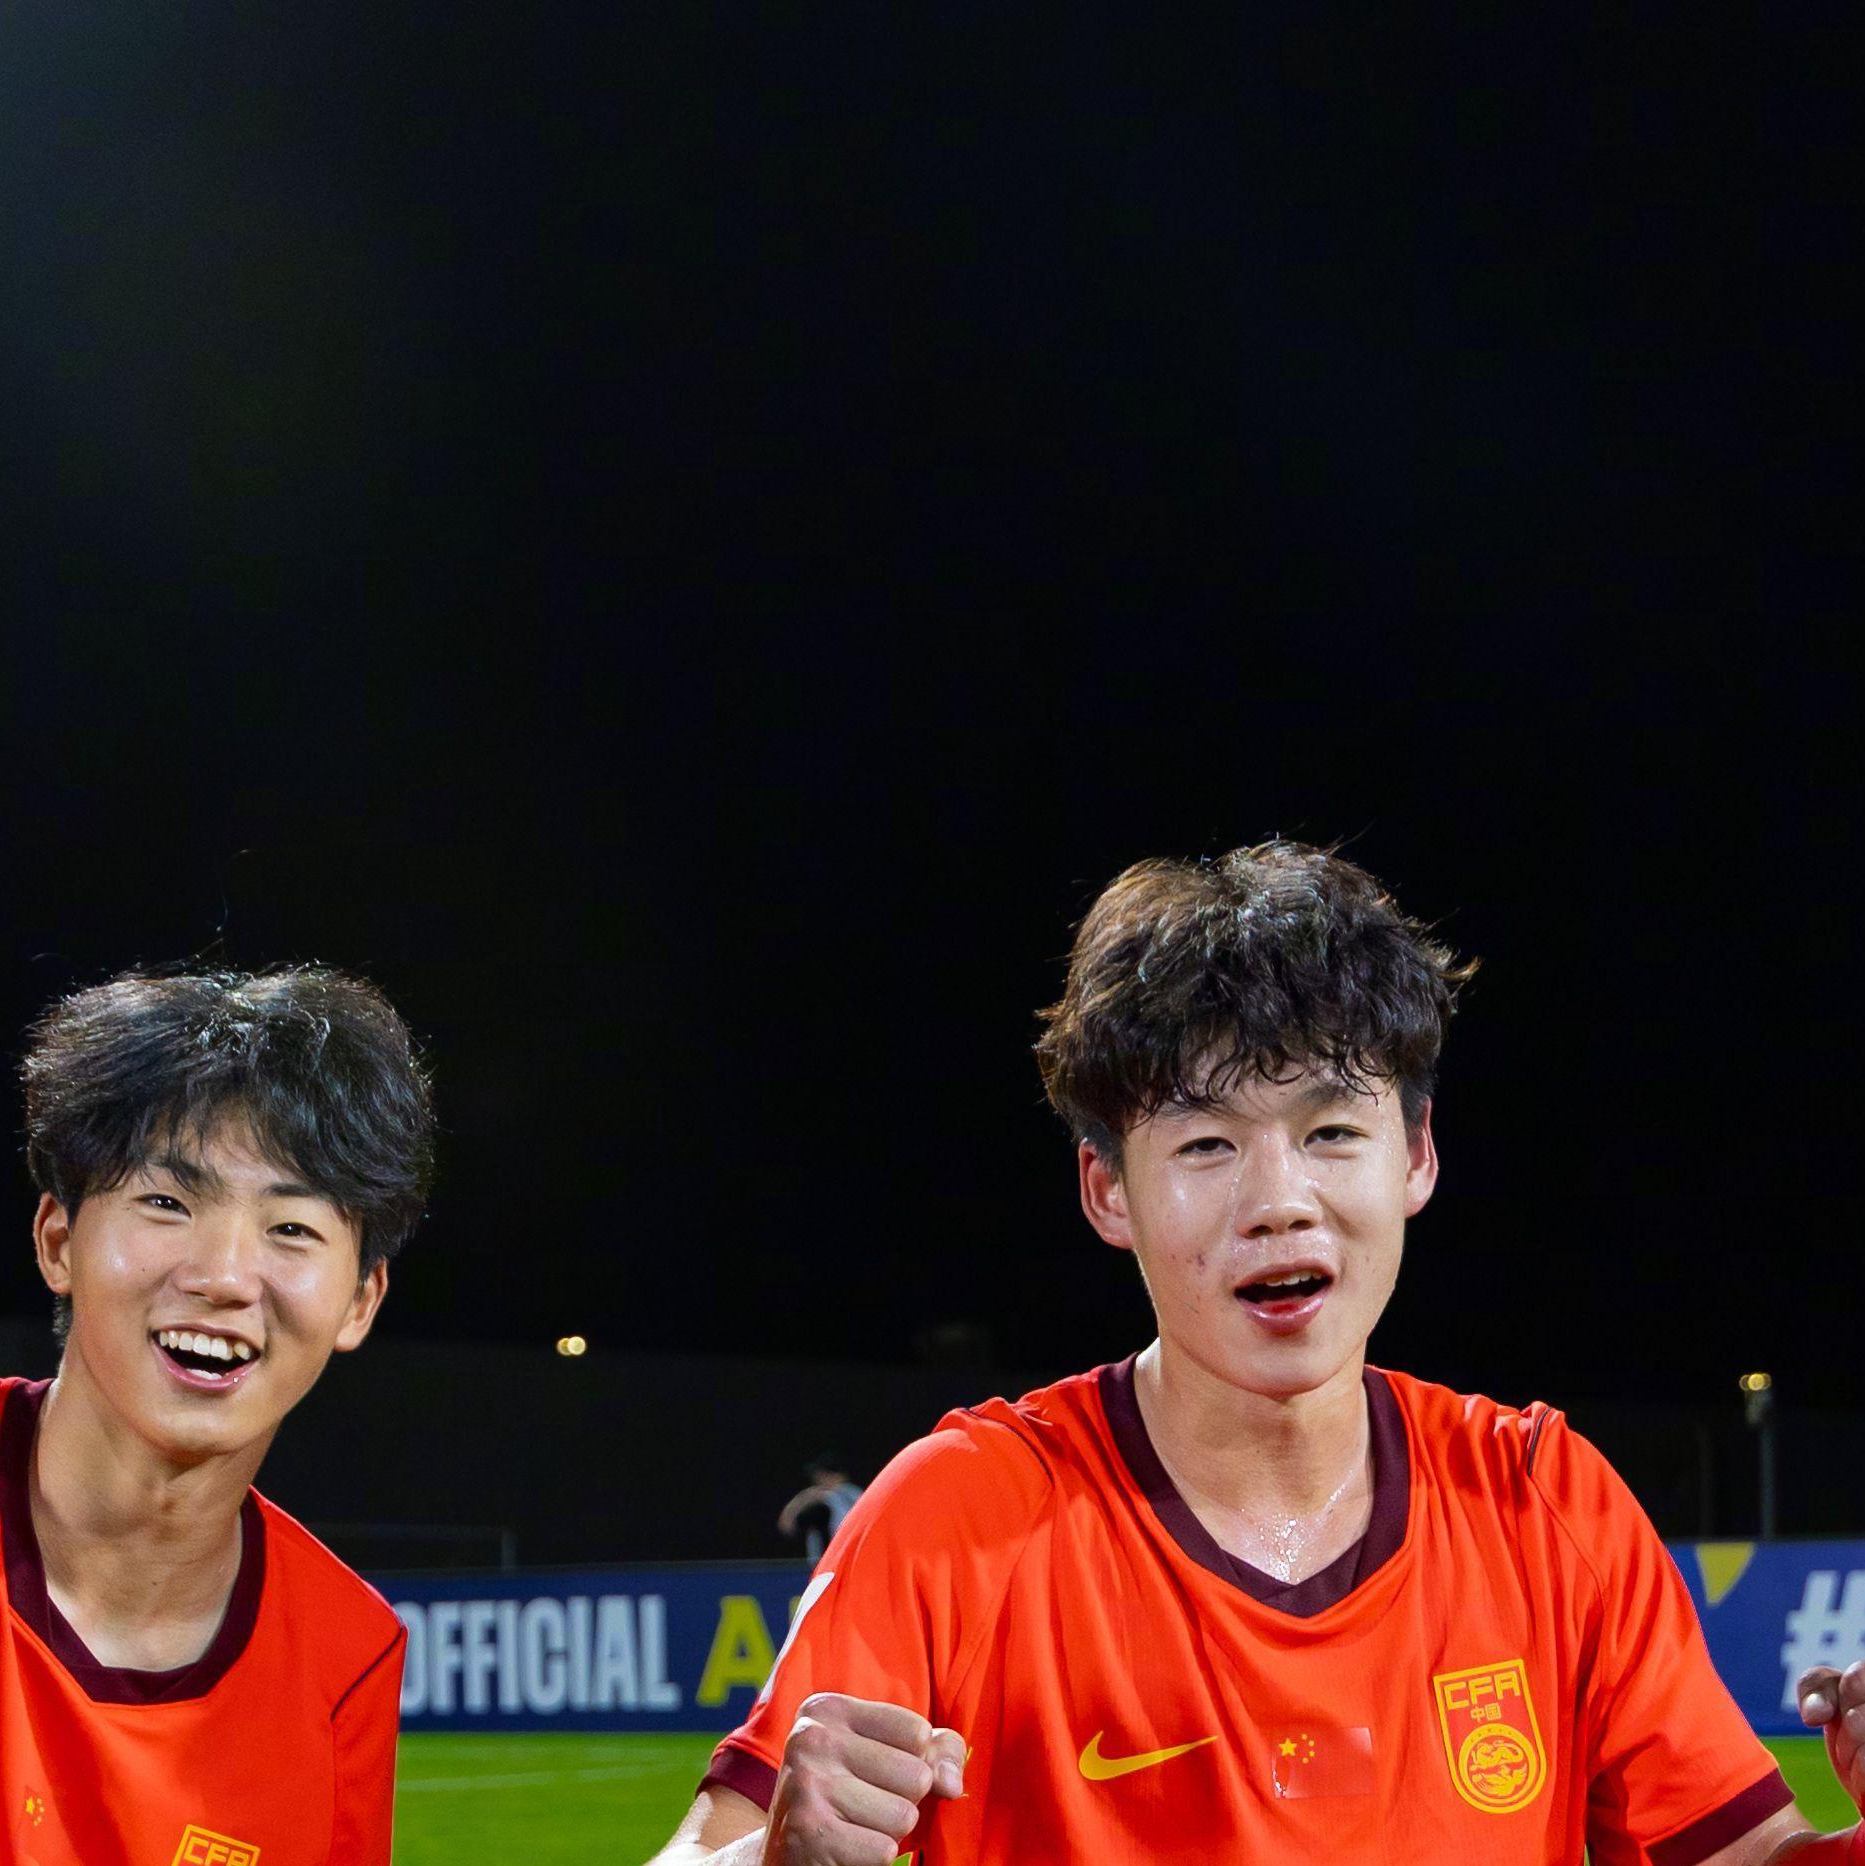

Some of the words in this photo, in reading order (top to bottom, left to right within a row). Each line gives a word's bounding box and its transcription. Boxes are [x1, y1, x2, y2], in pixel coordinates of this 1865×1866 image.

[392, 1595, 680, 1715] OFFICIAL
[1444, 1670, 1521, 1710] CFA
[1470, 1702, 1502, 1723] 中国
